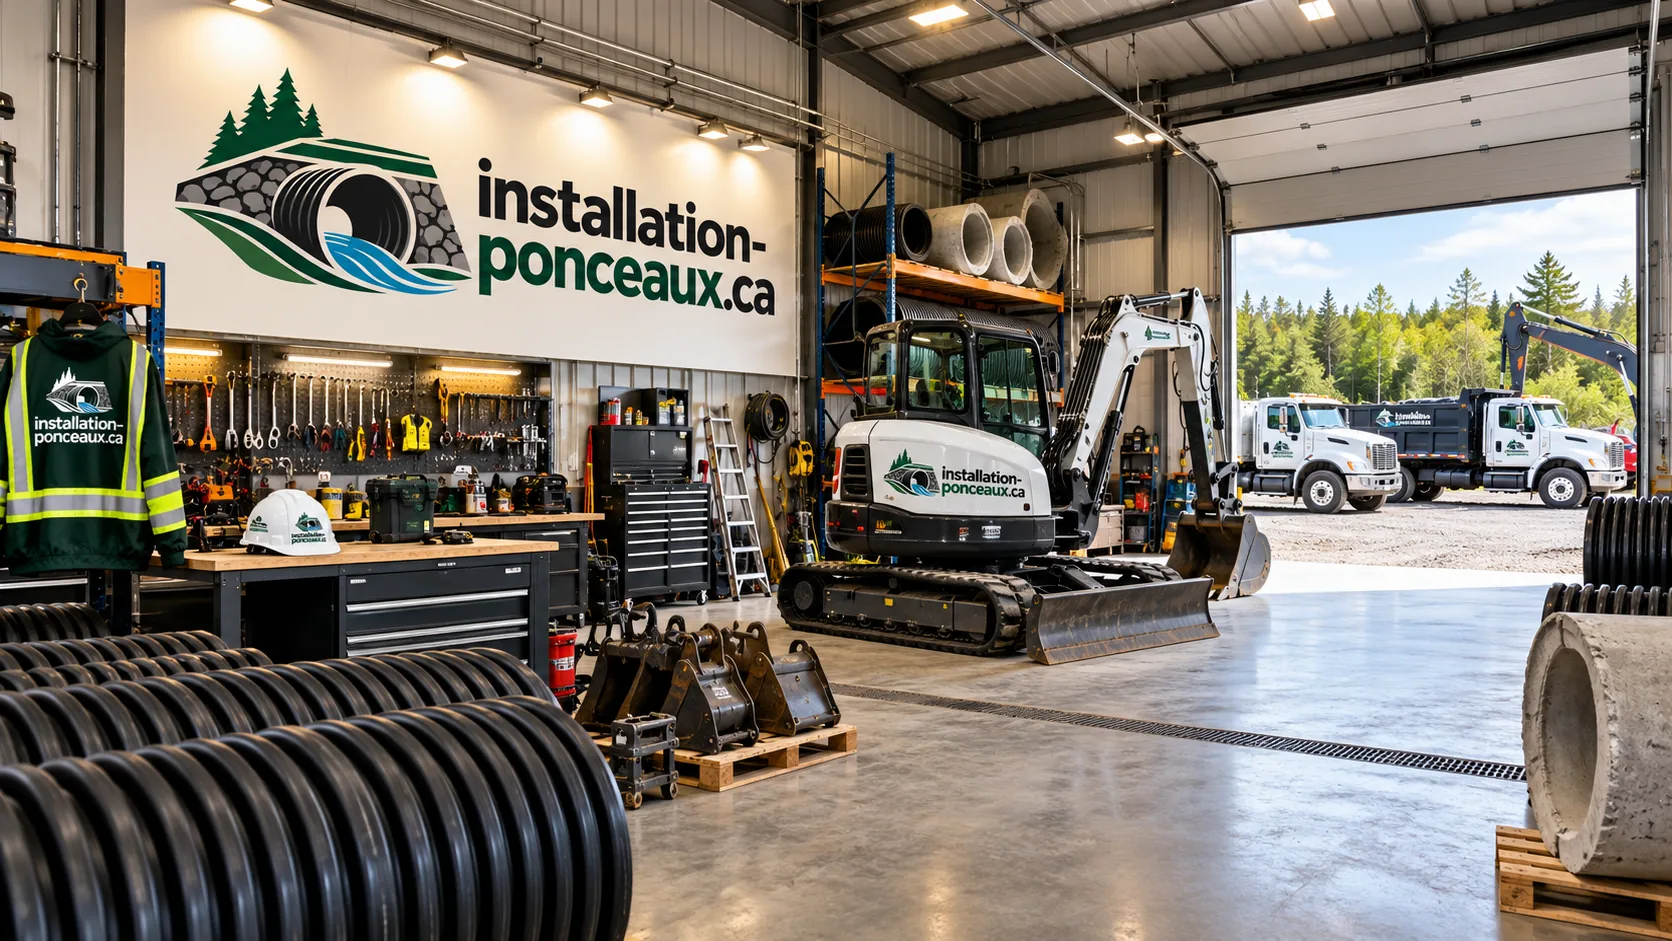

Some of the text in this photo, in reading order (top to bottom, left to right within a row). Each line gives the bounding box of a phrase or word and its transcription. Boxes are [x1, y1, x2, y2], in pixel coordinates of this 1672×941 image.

[478, 157, 766, 263] installation-
[478, 234, 775, 316] ponceaux.ca
[34, 416, 124, 431] installation-
[34, 432, 124, 447] ponceaux.ca
[941, 466, 1022, 485] installation-
[941, 482, 1025, 498] ponceaux.ca
